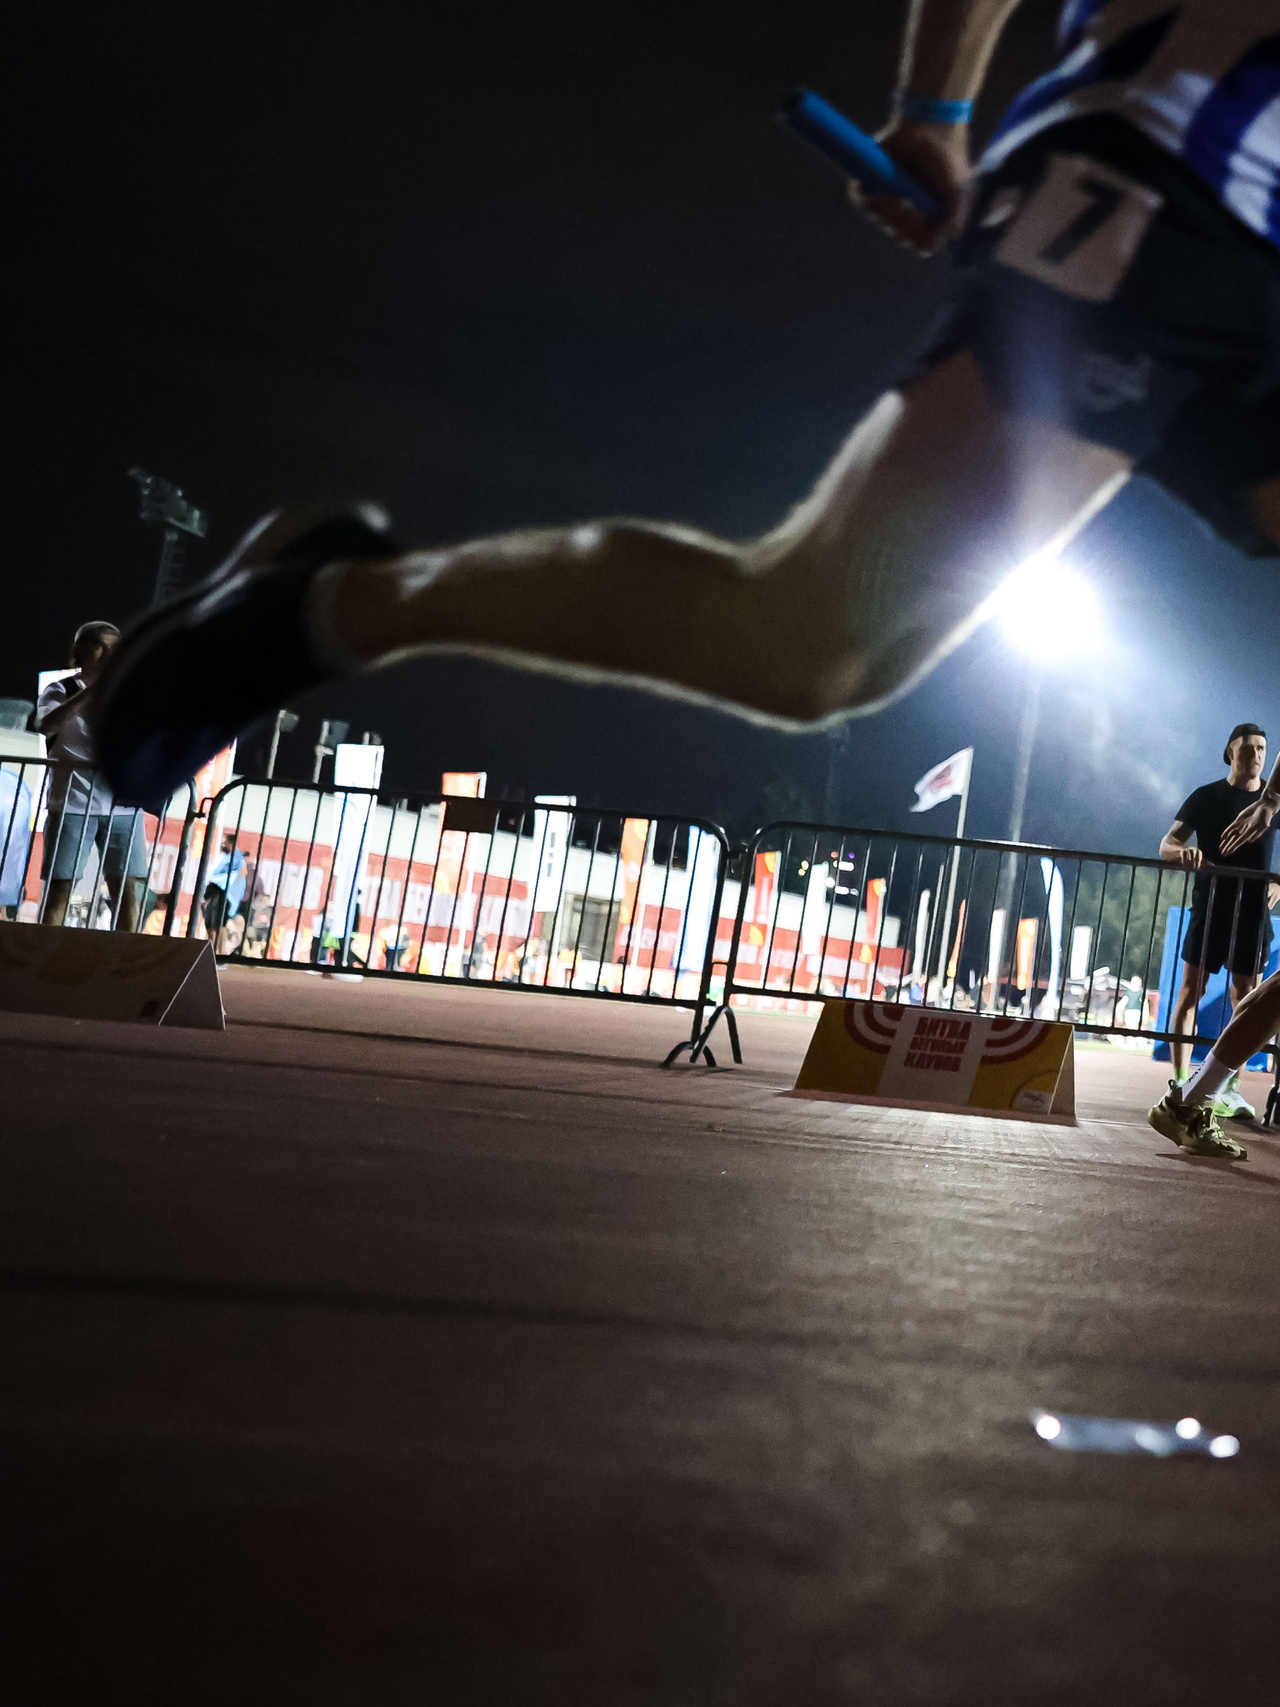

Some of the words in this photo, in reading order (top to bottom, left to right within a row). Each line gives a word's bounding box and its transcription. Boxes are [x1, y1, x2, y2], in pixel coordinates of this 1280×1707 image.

[1038, 173, 1128, 266] 7
[914, 1016, 972, 1041] БИТВА
[903, 1051, 962, 1072] КЛУБОВ
